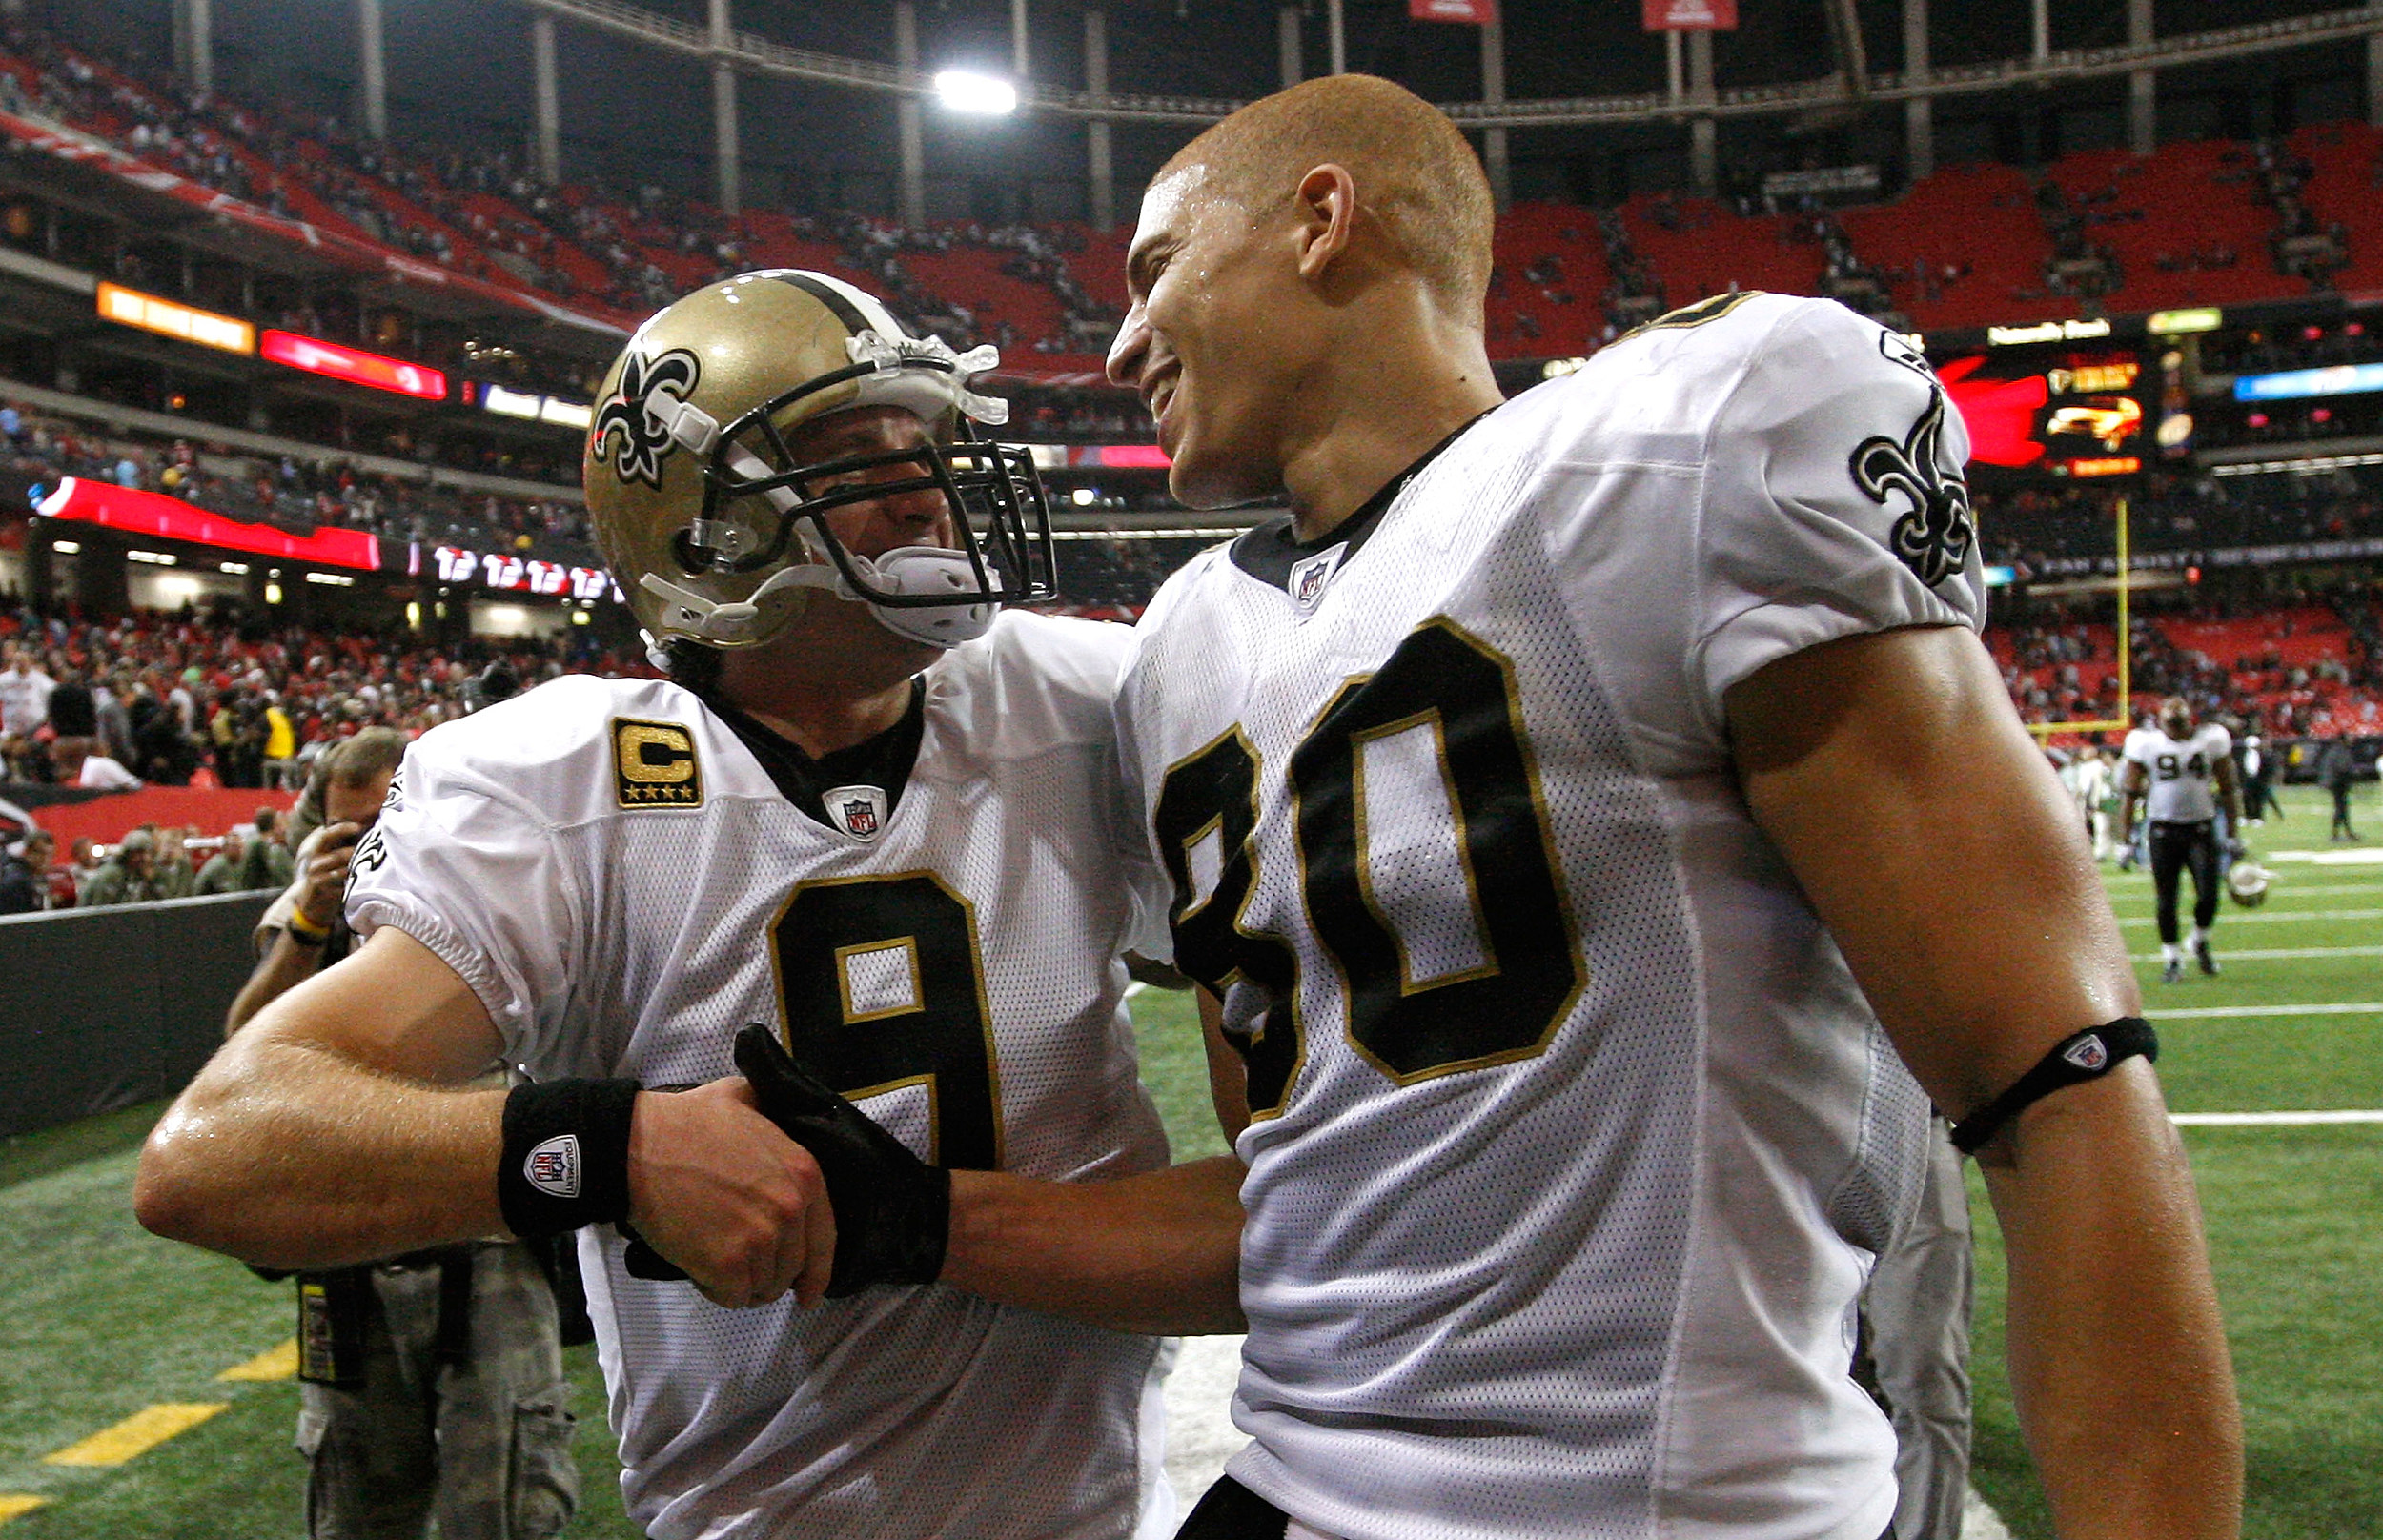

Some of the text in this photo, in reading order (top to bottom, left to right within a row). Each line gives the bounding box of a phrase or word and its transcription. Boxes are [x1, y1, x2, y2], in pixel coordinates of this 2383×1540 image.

[620, 724, 695, 783] C
[2157, 753, 2208, 781] 94
[847, 813, 877, 832] NFL
[1154, 615, 1589, 1124] 80
[765, 867, 1005, 1172] 9
[534, 1154, 553, 1181] NFL
